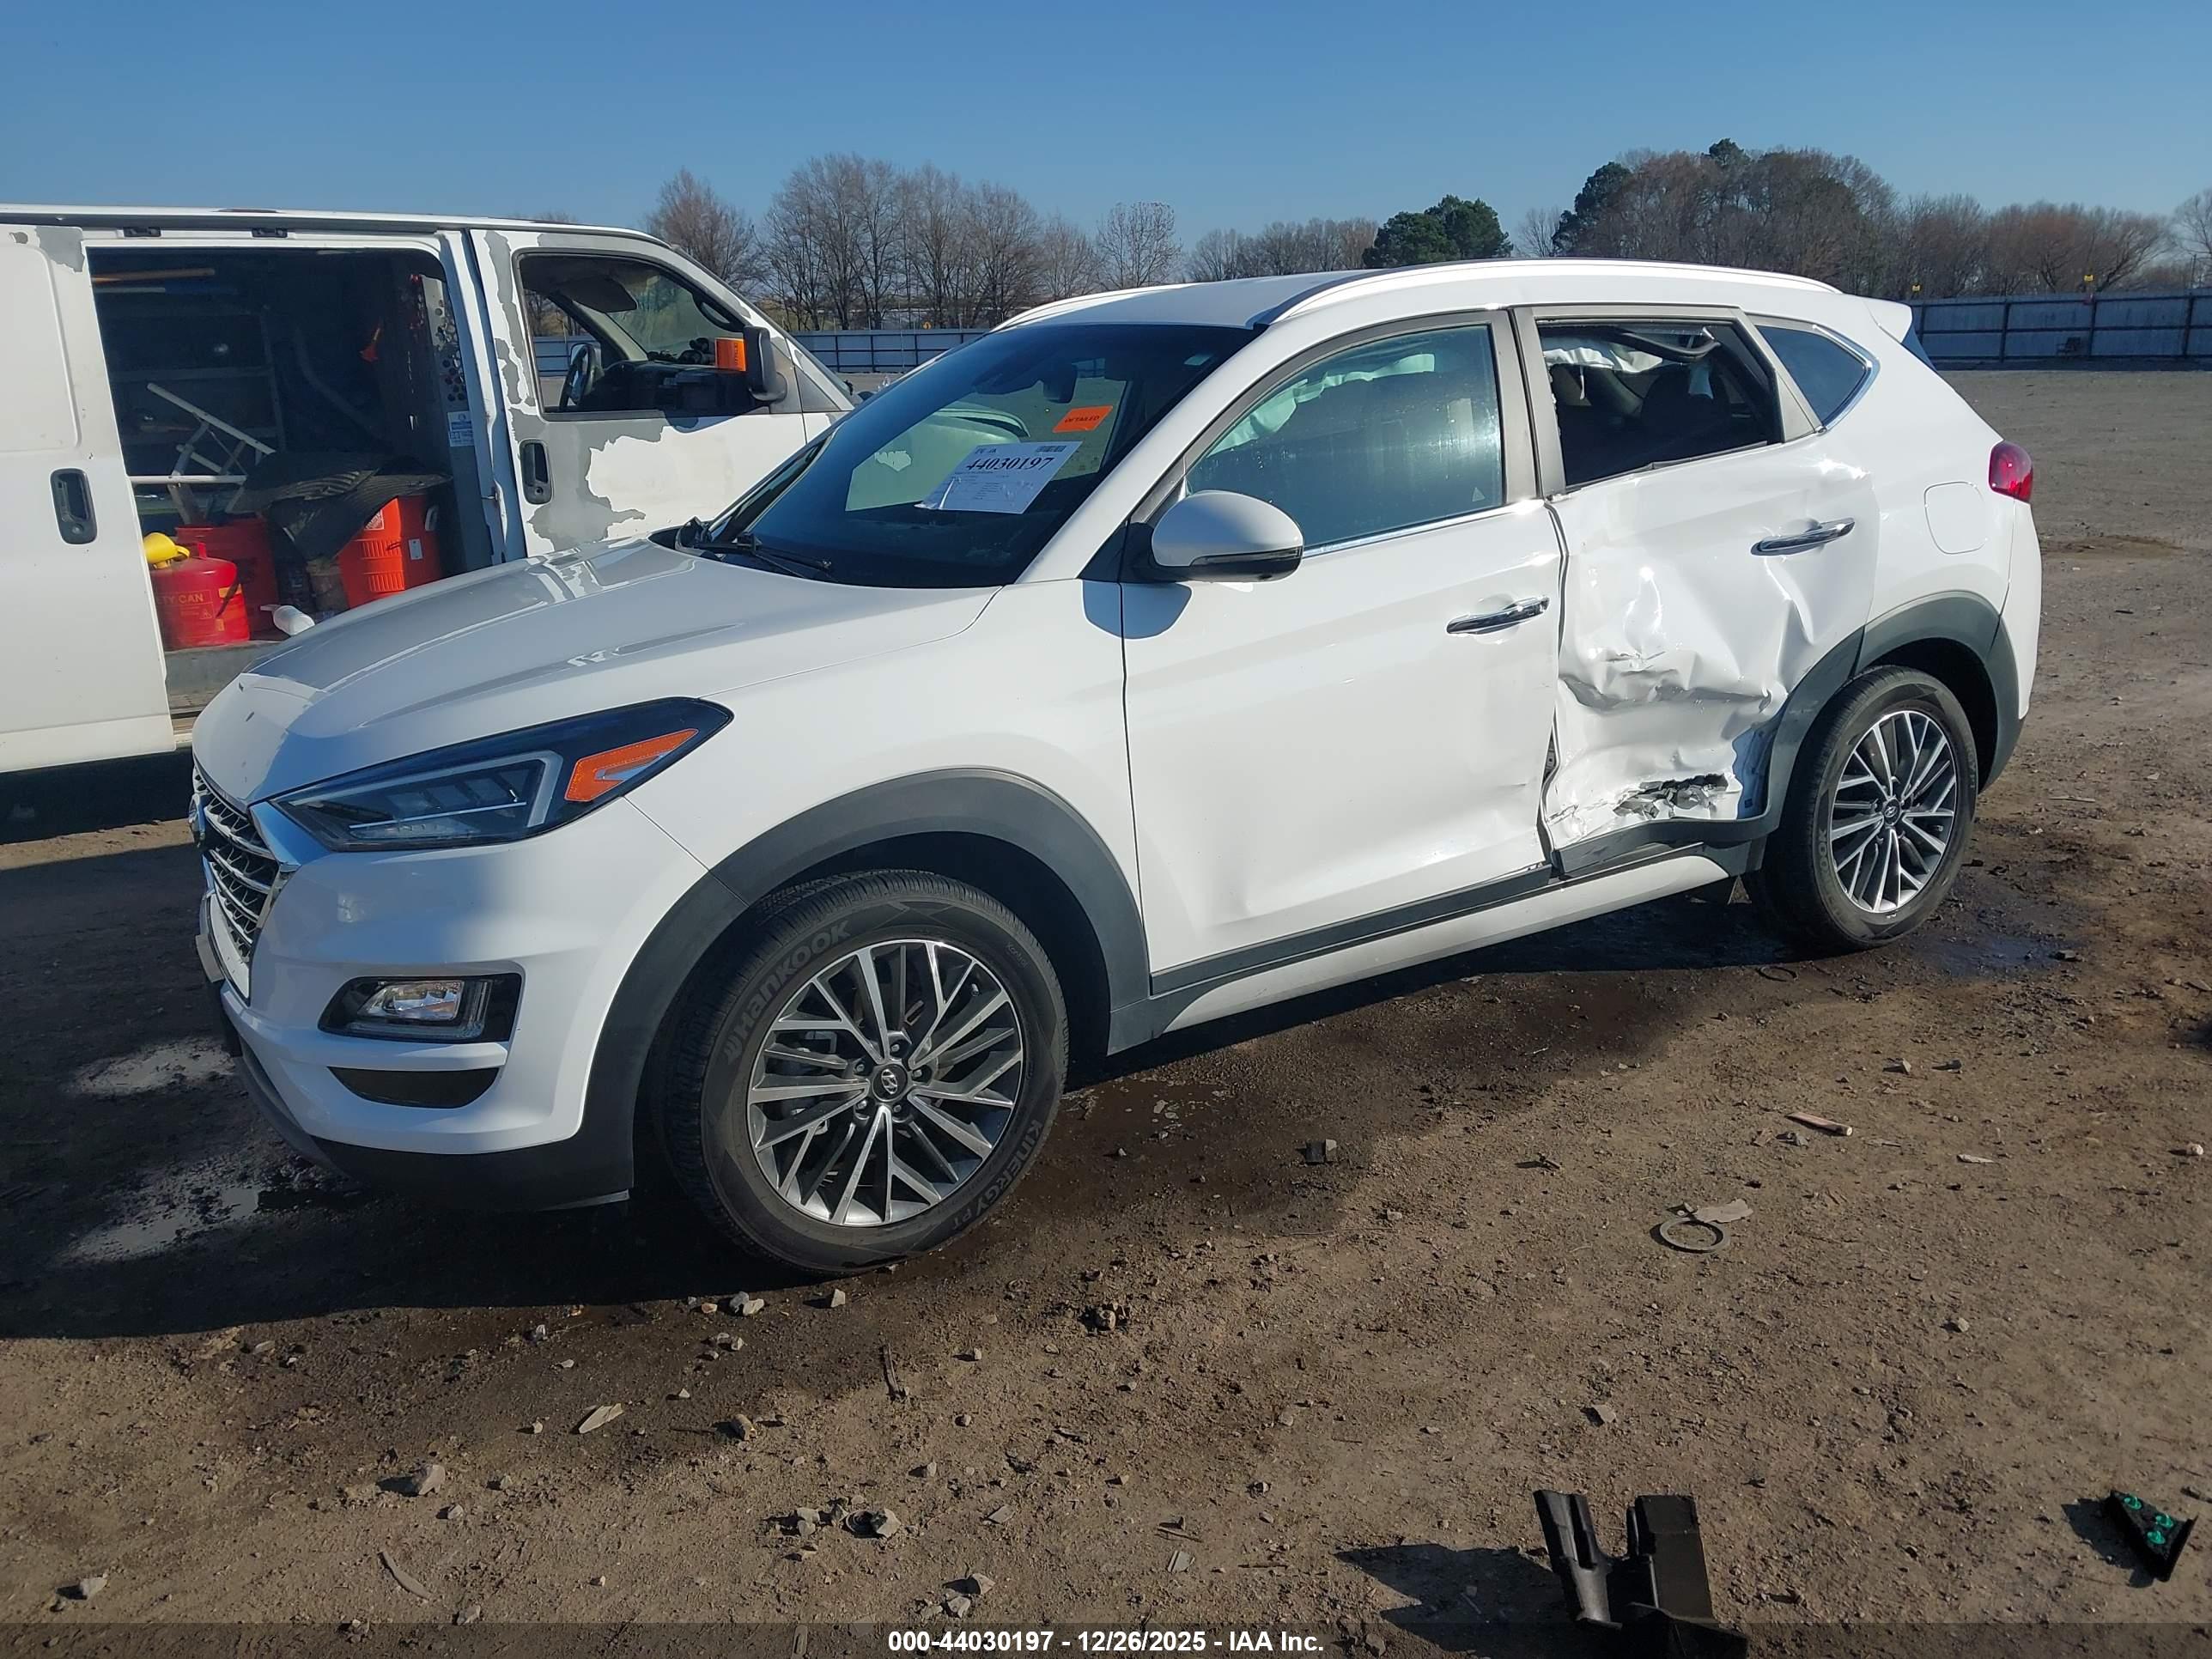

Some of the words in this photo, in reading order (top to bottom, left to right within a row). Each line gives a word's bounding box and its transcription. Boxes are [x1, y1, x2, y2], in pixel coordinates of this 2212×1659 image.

[966, 457, 1055, 471] 44030197
[179, 593, 204, 605] CAN
[975, 1119, 1044, 1216] KINERGY
